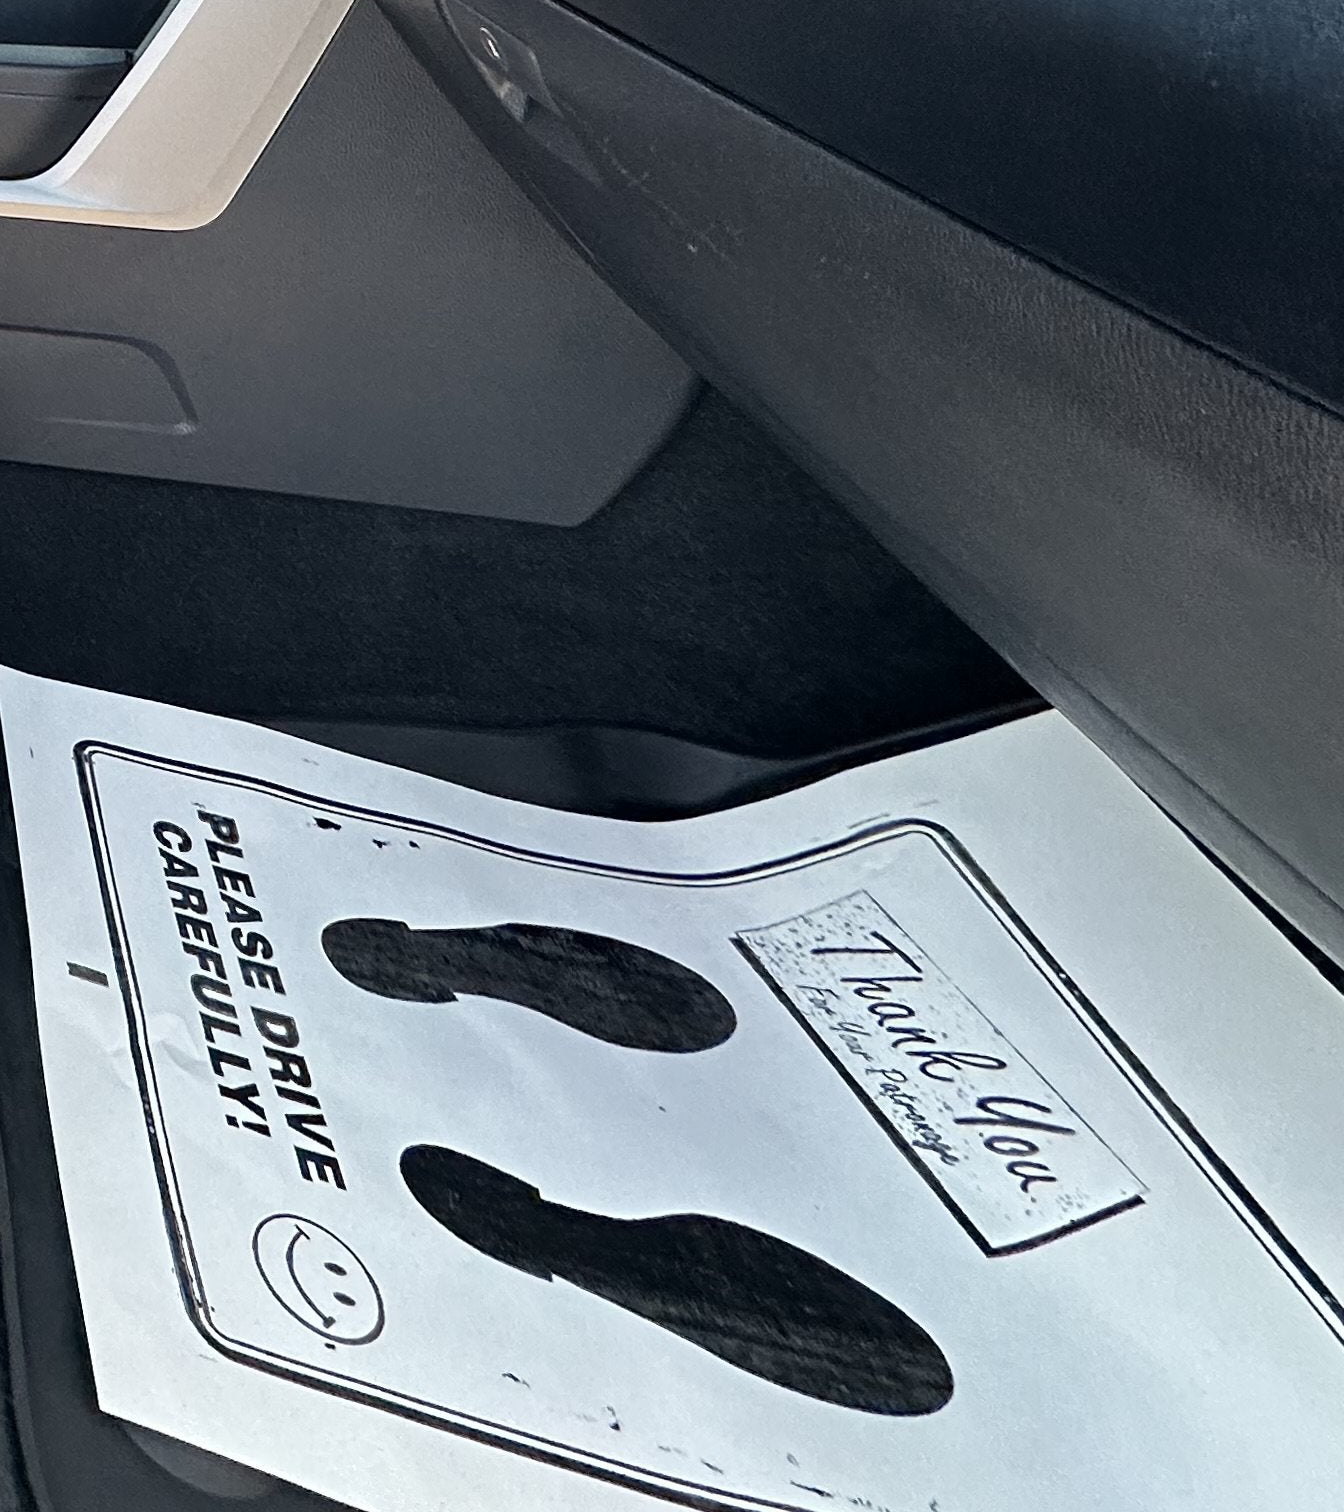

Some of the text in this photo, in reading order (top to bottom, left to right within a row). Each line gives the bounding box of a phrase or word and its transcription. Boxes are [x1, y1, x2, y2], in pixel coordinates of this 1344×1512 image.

[152, 819, 272, 1138] CAREFULLY!
[196, 807, 347, 1191] PLEASE DRIVE
[796, 984, 841, 1017] For
[811, 930, 1076, 1194] Thank You
